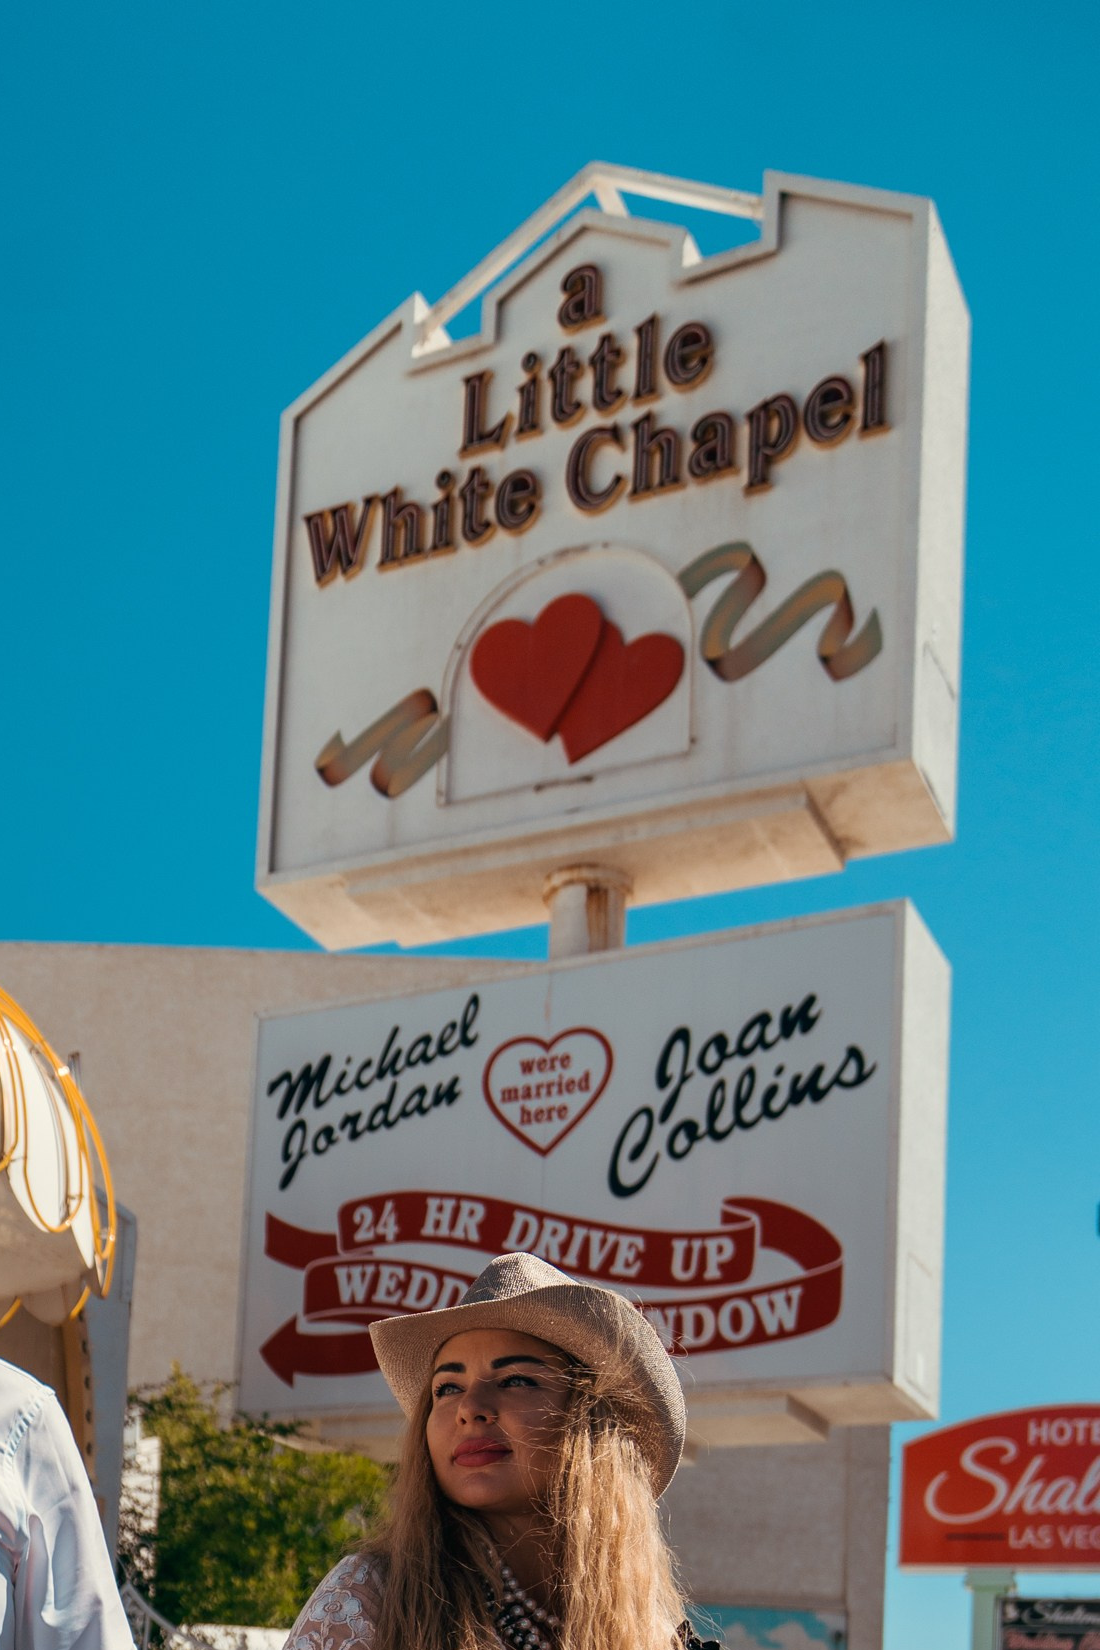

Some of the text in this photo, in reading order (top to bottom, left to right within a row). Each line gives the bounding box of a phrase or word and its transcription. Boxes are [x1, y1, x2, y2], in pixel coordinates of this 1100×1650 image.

[557, 263, 607, 336] a
[457, 311, 715, 460] Little
[303, 337, 891, 589] White Chapel
[267, 992, 480, 1120] Michael
[500, 1068, 591, 1104] married
[519, 1052, 571, 1076] were
[655, 993, 822, 1125] Joan
[278, 1075, 461, 1191] Jordan
[519, 1103, 568, 1126] here
[607, 1044, 877, 1199] Collins
[353, 1196, 736, 1282] 24 HR DRIVE UP
[334, 1261, 803, 1350] WEDD NDOW
[1027, 1417, 1100, 1446] HOTE
[924, 1436, 1100, 1525] Shal
[1008, 1524, 1053, 1549] LAS
